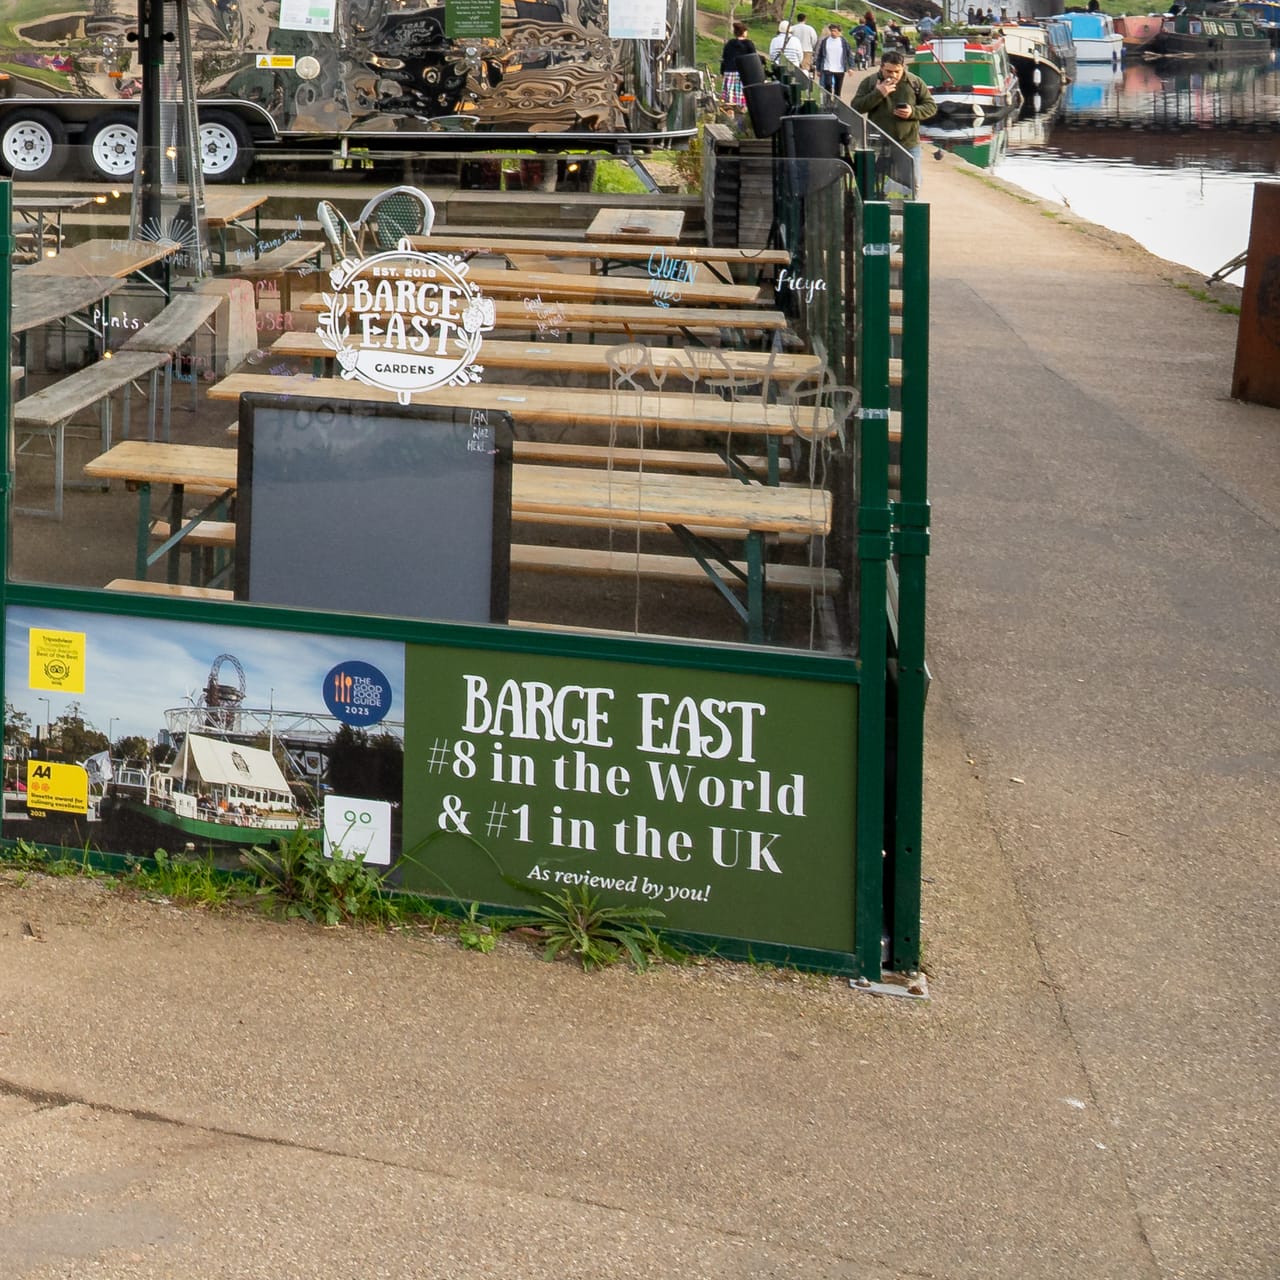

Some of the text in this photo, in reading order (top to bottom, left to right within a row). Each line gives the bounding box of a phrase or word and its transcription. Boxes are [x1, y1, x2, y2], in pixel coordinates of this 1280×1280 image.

[373, 267, 436, 278] EST. 2018
[352, 280, 461, 319] BARGE
[360, 313, 456, 355] EAST
[375, 364, 435, 374] GARDENS
[353, 690, 380, 698] FOOD
[354, 684, 383, 692] GOOD
[354, 698, 381, 707] GUIDE
[345, 706, 369, 715] 2025
[462, 675, 765, 763] BARGE EAST
[32, 765, 51, 779] AA
[427, 738, 807, 817] #8 in the World
[438, 794, 783, 874] & #1 in the UK
[527, 865, 711, 903] As reviewed by you!
